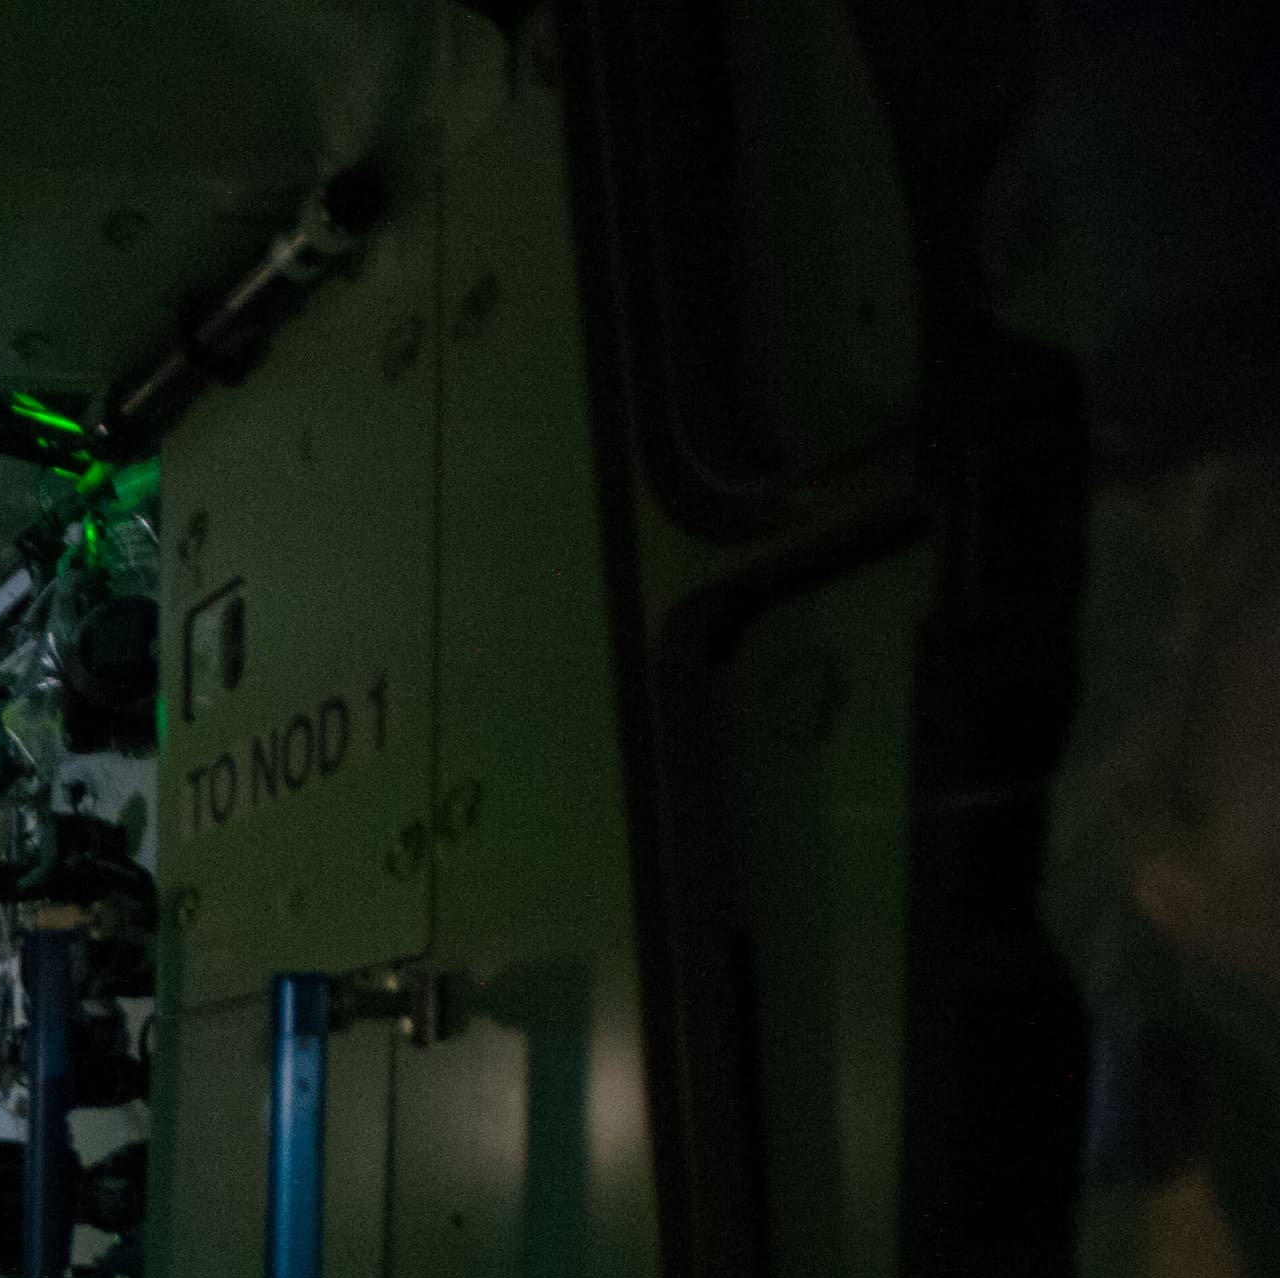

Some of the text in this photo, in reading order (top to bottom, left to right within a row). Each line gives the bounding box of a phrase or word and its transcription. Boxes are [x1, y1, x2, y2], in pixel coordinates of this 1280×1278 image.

[189, 674, 387, 832] TO NOD 1
